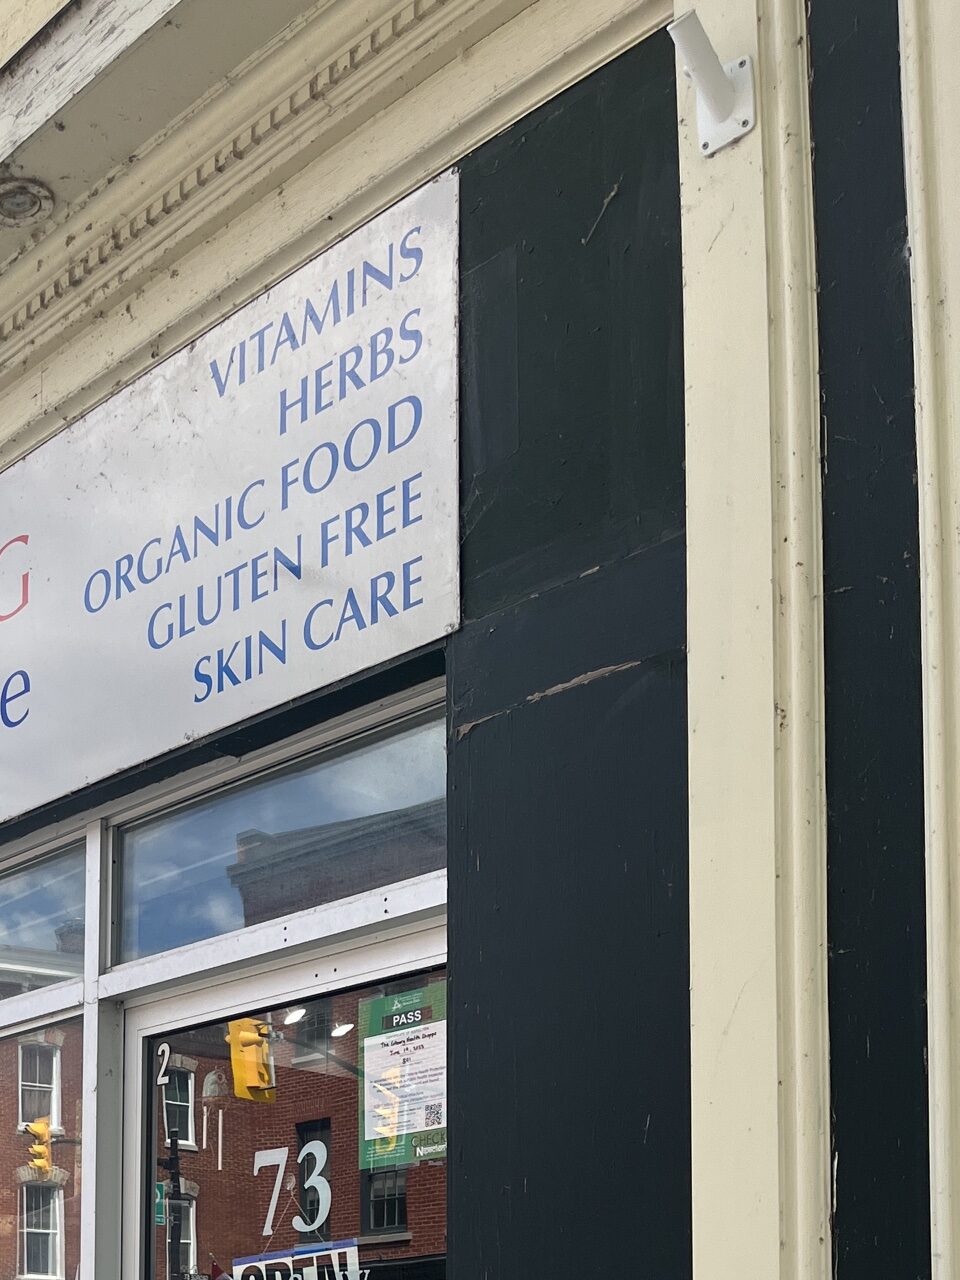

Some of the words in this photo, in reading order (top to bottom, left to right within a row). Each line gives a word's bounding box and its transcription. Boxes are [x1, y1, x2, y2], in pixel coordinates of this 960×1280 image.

[209, 225, 423, 397] VITAMINS
[279, 308, 423, 436] HERBS
[84, 479, 265, 614] ORGANIC
[280, 395, 423, 511] FOOD
[147, 534, 302, 650] GLUTEN
[321, 472, 423, 568] FREE
[194, 619, 287, 703] SKIN
[303, 555, 423, 651] CARE
[156, 1042, 171, 1086] 2
[393, 1010, 421, 1026] PASS
[253, 1140, 332, 1237] 73
